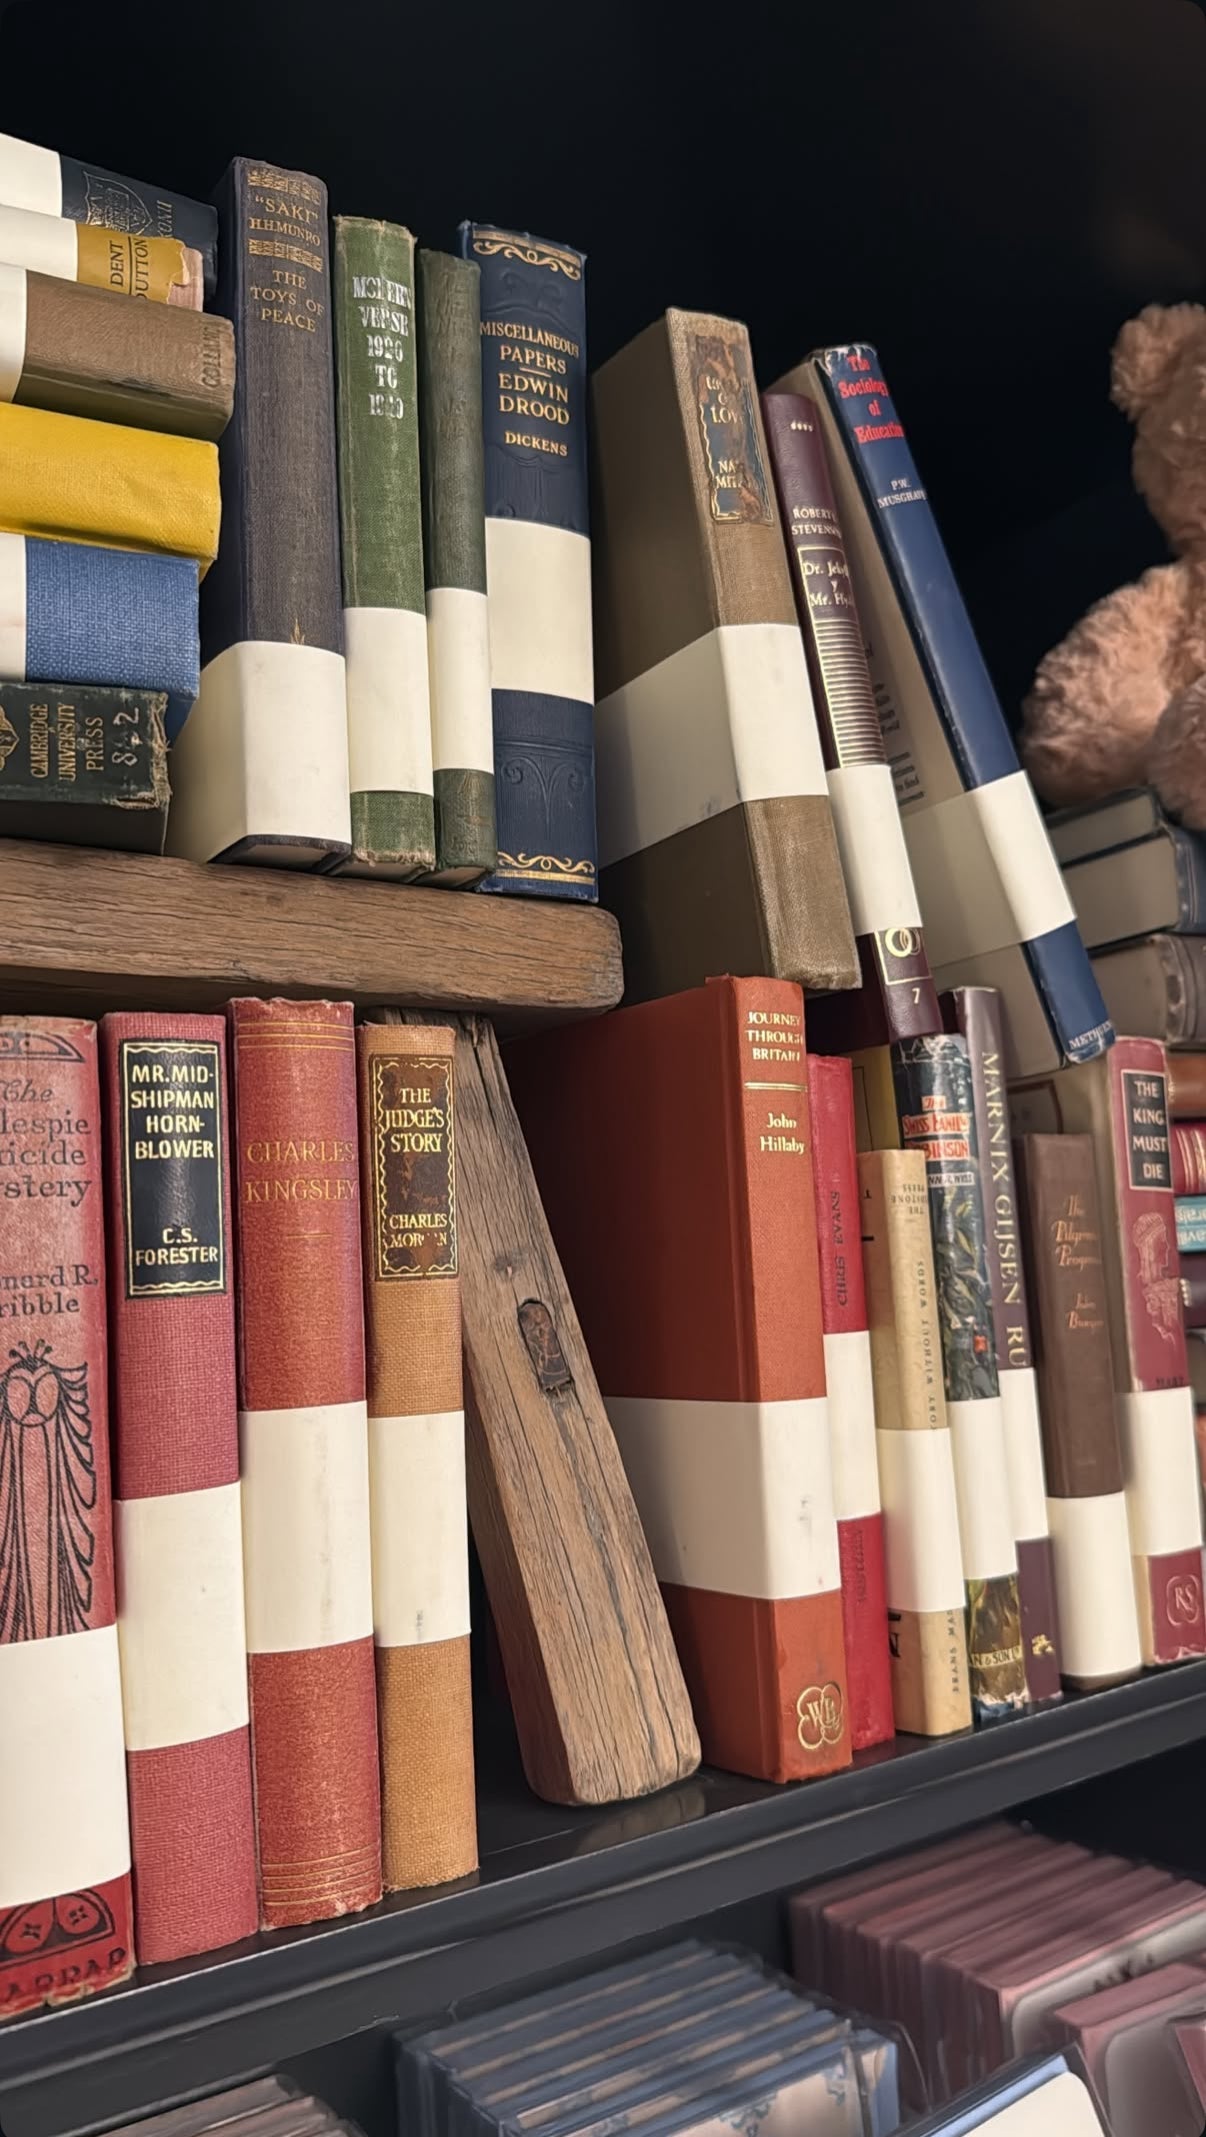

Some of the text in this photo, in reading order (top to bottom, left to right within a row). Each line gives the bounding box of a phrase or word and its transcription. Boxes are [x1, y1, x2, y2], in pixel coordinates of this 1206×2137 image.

[109, 240, 124, 287] DENT
[272, 270, 307, 290] THE
[250, 286, 325, 316] TOYS OF
[261, 308, 316, 333] PEACE
[500, 344, 567, 375] PAPERS
[498, 372, 569, 404] EDWIN
[499, 394, 571, 425] DROOD
[867, 400, 882, 416] of
[505, 430, 569, 457] DICKENS
[29, 703, 49, 778] CAMBRIDGE
[57, 702, 76, 782] UNIVERSITY
[85, 716, 104, 771] PRESS
[911, 988, 920, 1004] 7
[399, 1087, 432, 1104] THE
[1134, 1080, 1160, 1098] THE
[131, 1090, 214, 1109] SHIPMAN
[146, 1114, 206, 1134] HORN-
[766, 1112, 797, 1129] John
[981, 1051, 1010, 1183] MARNIX
[1133, 1108, 1165, 1126] KING
[135, 1140, 215, 1160] BLOWER
[246, 1140, 354, 1164] CHARLES
[391, 1132, 443, 1153] STORY
[759, 1135, 805, 1155] Hillaby
[1132, 1135, 1168, 1153] MUST
[1143, 1163, 1165, 1180] DIE
[247, 1178, 357, 1203] KINGSLEY
[389, 1213, 448, 1230] CHARLES
[162, 1228, 198, 1244] C.S.
[388, 1231, 448, 1249] MORN
[135, 1247, 219, 1266] FORESTER
[993, 1193, 1021, 1305] GIJSEN
[916, 1260, 928, 1308] WORDS
[921, 1318, 934, 1385] WITHOUT
